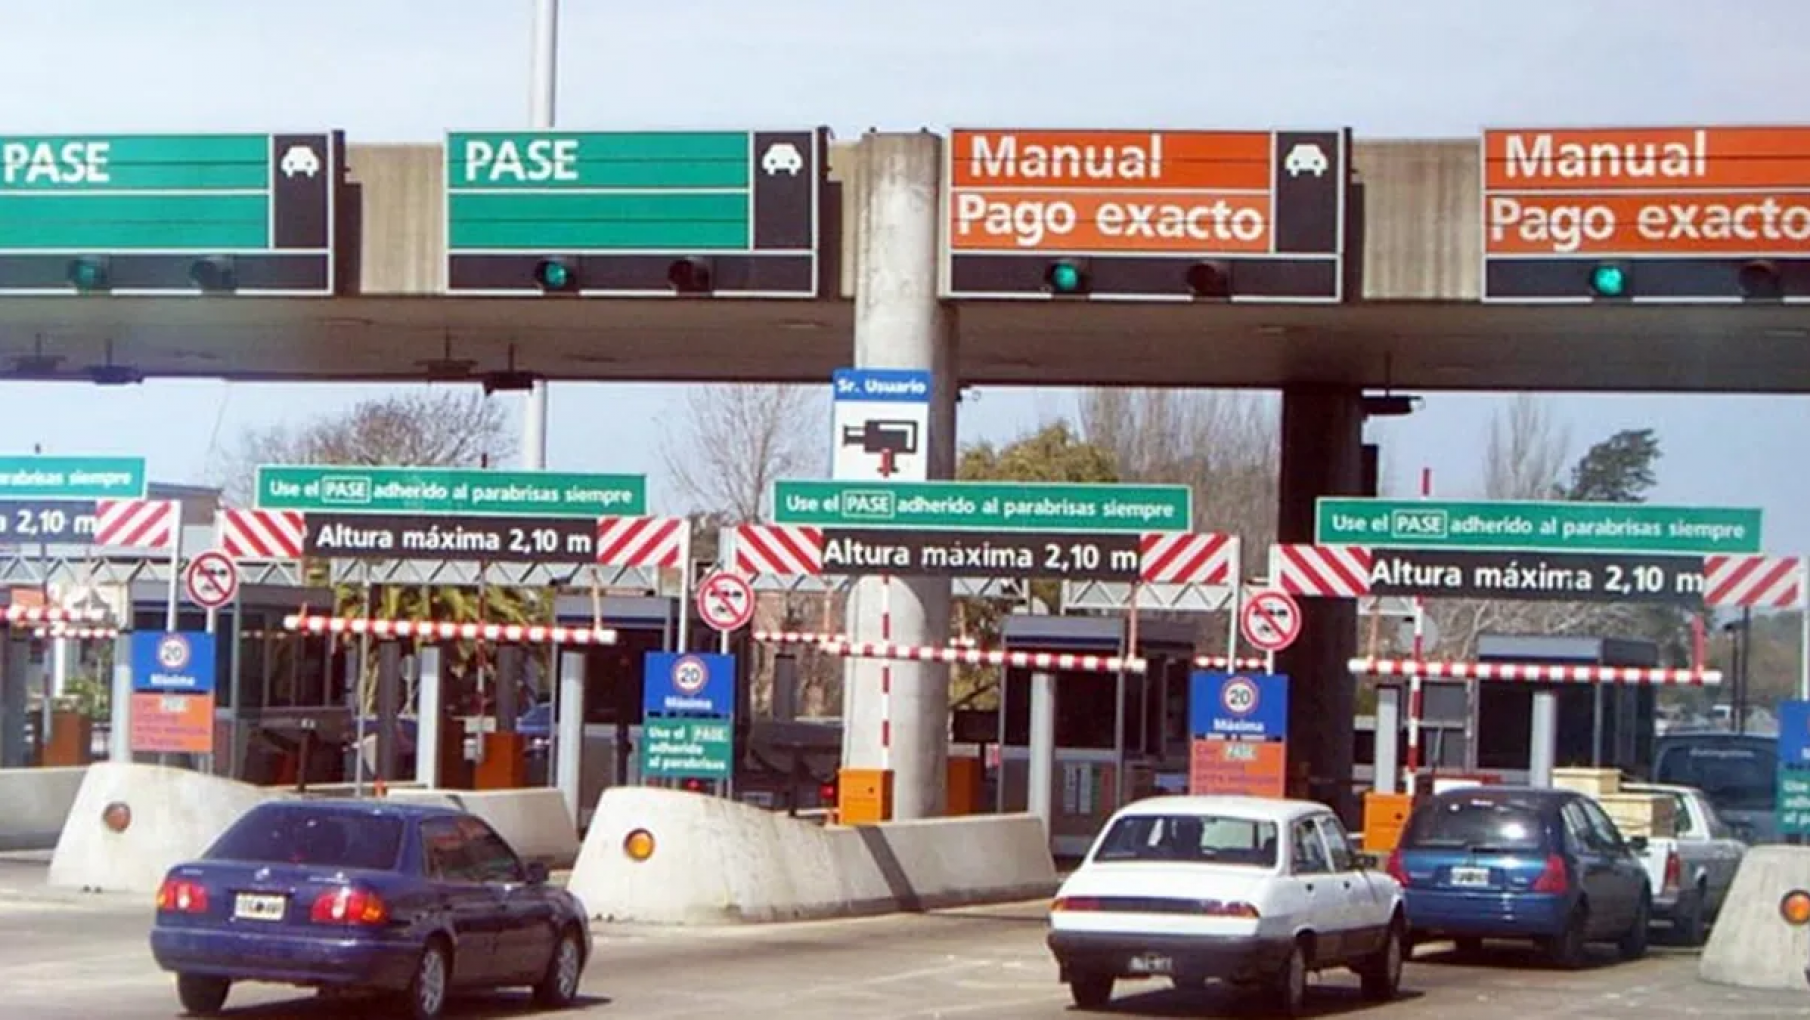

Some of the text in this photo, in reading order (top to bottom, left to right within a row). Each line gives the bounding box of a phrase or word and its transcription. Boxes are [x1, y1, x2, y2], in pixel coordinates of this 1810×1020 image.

[3, 141, 110, 183] PASE
[465, 139, 579, 181] PASE
[970, 134, 1162, 178] Manual
[1505, 130, 1707, 179] Manual
[957, 193, 1264, 247] Pago exacto
[1490, 197, 1810, 252] Pago exacto
[837, 378, 927, 394] Sr. Usuario
[269, 480, 633, 507] Use el PASE adherido al parabrisas siempre
[786, 495, 1175, 521] Use el PASE adherido al parabrisas siempre
[16, 510, 66, 535] 2,10
[73, 515, 95, 534] m
[316, 523, 592, 554] Altura máxima 2,10 m
[1332, 514, 1745, 542] Use el PASE adherido al parabrisas siempre
[823, 538, 1138, 572] Altura máxima 2,10 m
[1371, 557, 1703, 594] Altura máxima 2,10 m
[681, 668, 700, 683] 20
[1229, 688, 1251, 705] 20
